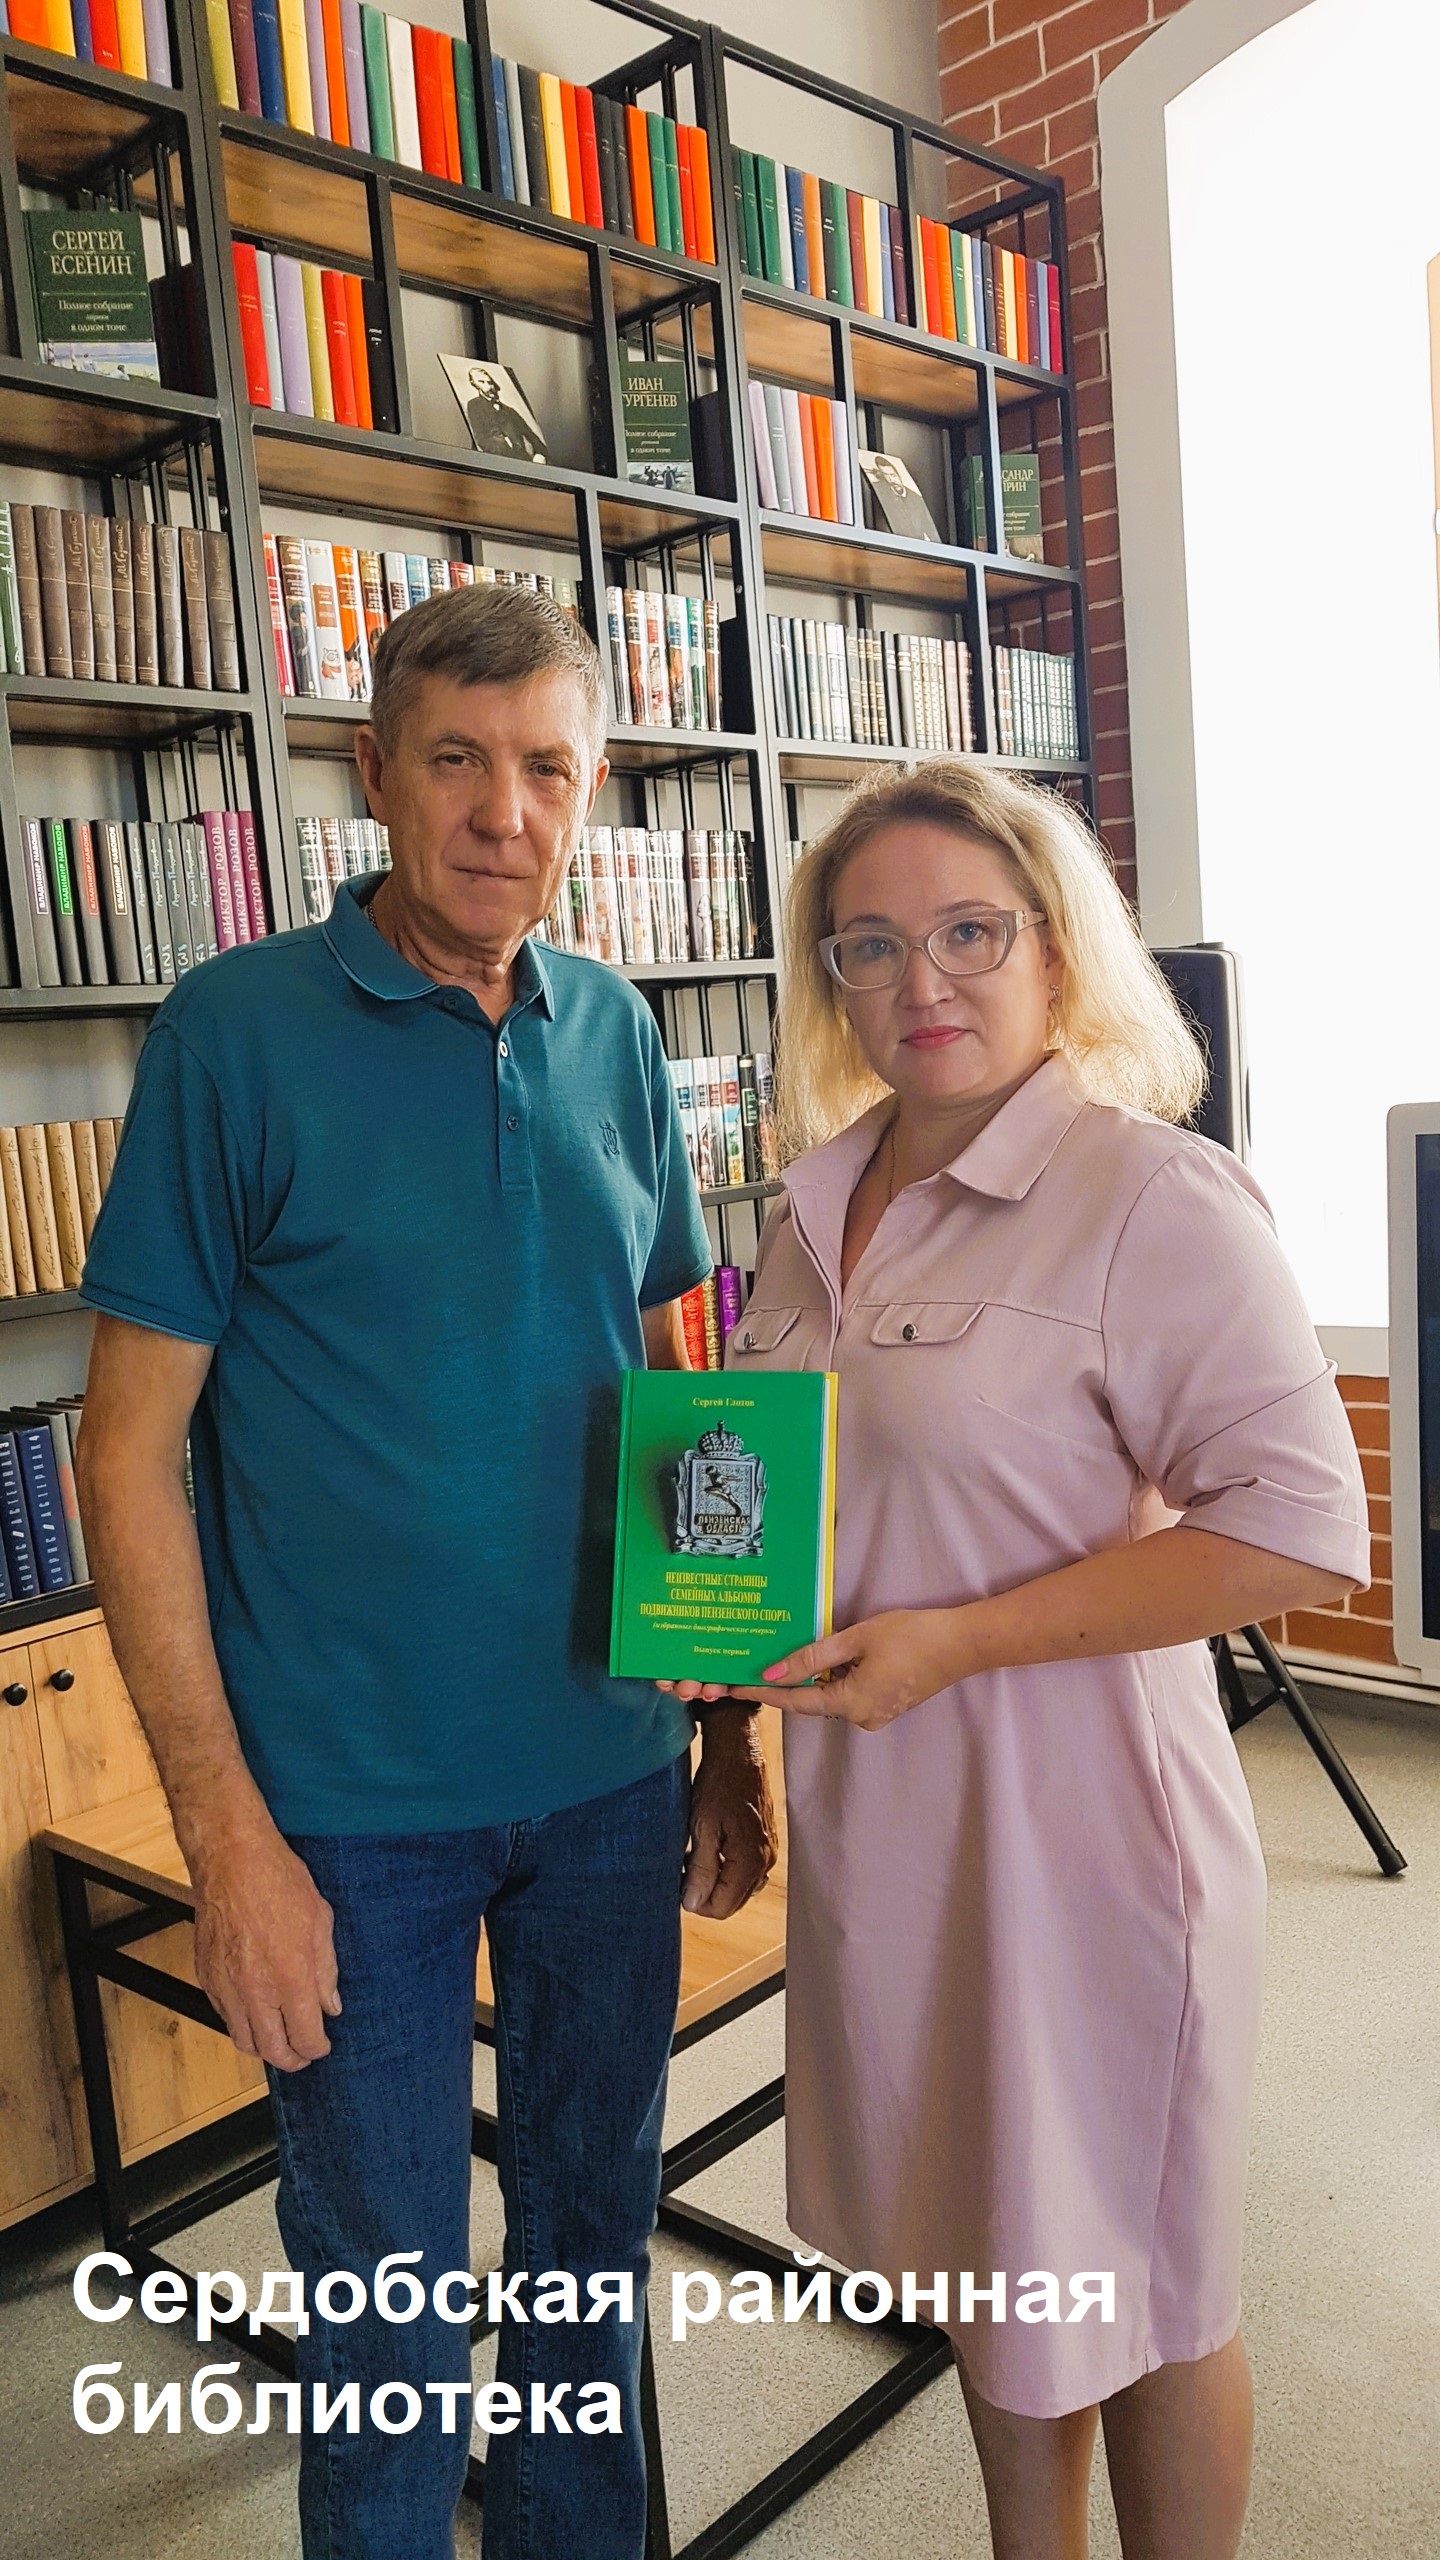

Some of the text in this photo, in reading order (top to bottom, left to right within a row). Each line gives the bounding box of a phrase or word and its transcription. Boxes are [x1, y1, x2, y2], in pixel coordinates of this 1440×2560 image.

[52, 229, 126, 251] СЕРГЕЙ
[51, 255, 132, 275] ЕСЕНИН
[59, 300, 134, 312] Полное собрание
[77, 324, 104, 332] одном
[628, 377, 663, 391] ИВАН
[14, 650, 21, 664] 6
[81, 650, 87, 658] 3
[29, 822, 46, 909] ВЛАДИМИР НАБОКОВ
[55, 824, 70, 909] ВЛАДИМИР НАБОКОВ
[82, 825, 96, 909] ВЛАДИМИР НАБОКОВ
[109, 826, 124, 909] ВЛАДИМИР НАБОКОВ
[211, 826, 232, 935] ВИКТОР РОЗОВ
[228, 828, 249, 936] ВИКТОР РОЗОВ
[244, 827, 266, 935] ВИКТОР РОЗОВ
[146, 952, 153, 966] 1
[162, 952, 171, 967] 2
[177, 952, 188, 966] 3
[7, 1139, 14, 1149] 4
[83, 1135, 89, 1145] 7
[692, 1397, 755, 1408] Сергей Глотов
[28, 1434, 64, 1584] БОРИС ПАСТЕРНАК 4
[698, 1515, 750, 1525] ПЕНЗЕНСКАЯ
[706, 1524, 742, 1533] ОБЛАСТЬ
[15, 1543, 34, 1591] БОРИС
[666, 1572, 768, 1589] НЕИЗВЕСТНЫЕ СТРАНИЦЫ
[670, 1587, 762, 1604] СЕМЕЙНЫХ АЛЬБОМОВ
[640, 1603, 792, 1622] ПОДВИЖНИКОВ ПЕНЗЕНСКОГО СПОРТА
[693, 1623, 749, 1633] биографические
[694, 1645, 750, 1657] Выпуск первый
